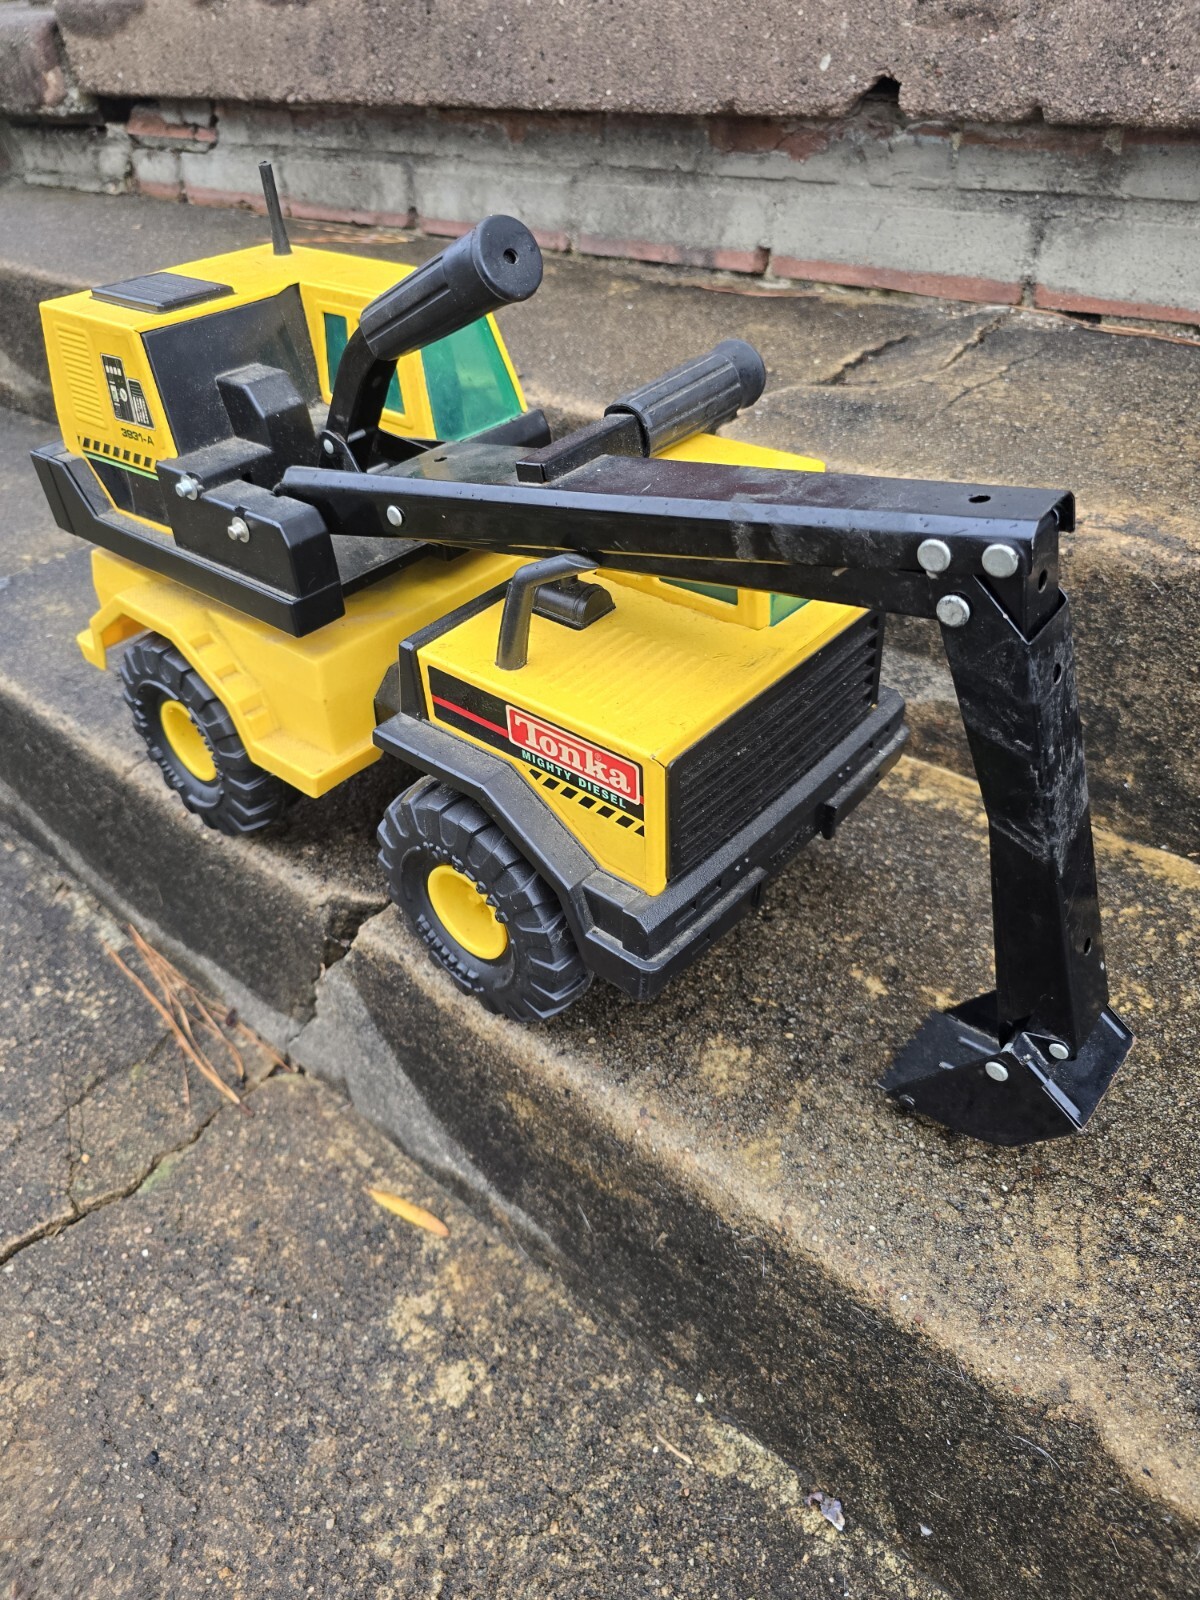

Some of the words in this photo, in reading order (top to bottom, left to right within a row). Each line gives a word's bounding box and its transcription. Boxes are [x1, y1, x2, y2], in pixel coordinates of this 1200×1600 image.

[514, 714, 632, 794] Tonka
[521, 748, 572, 781] MIGHTY
[578, 776, 627, 810] DIESEL
